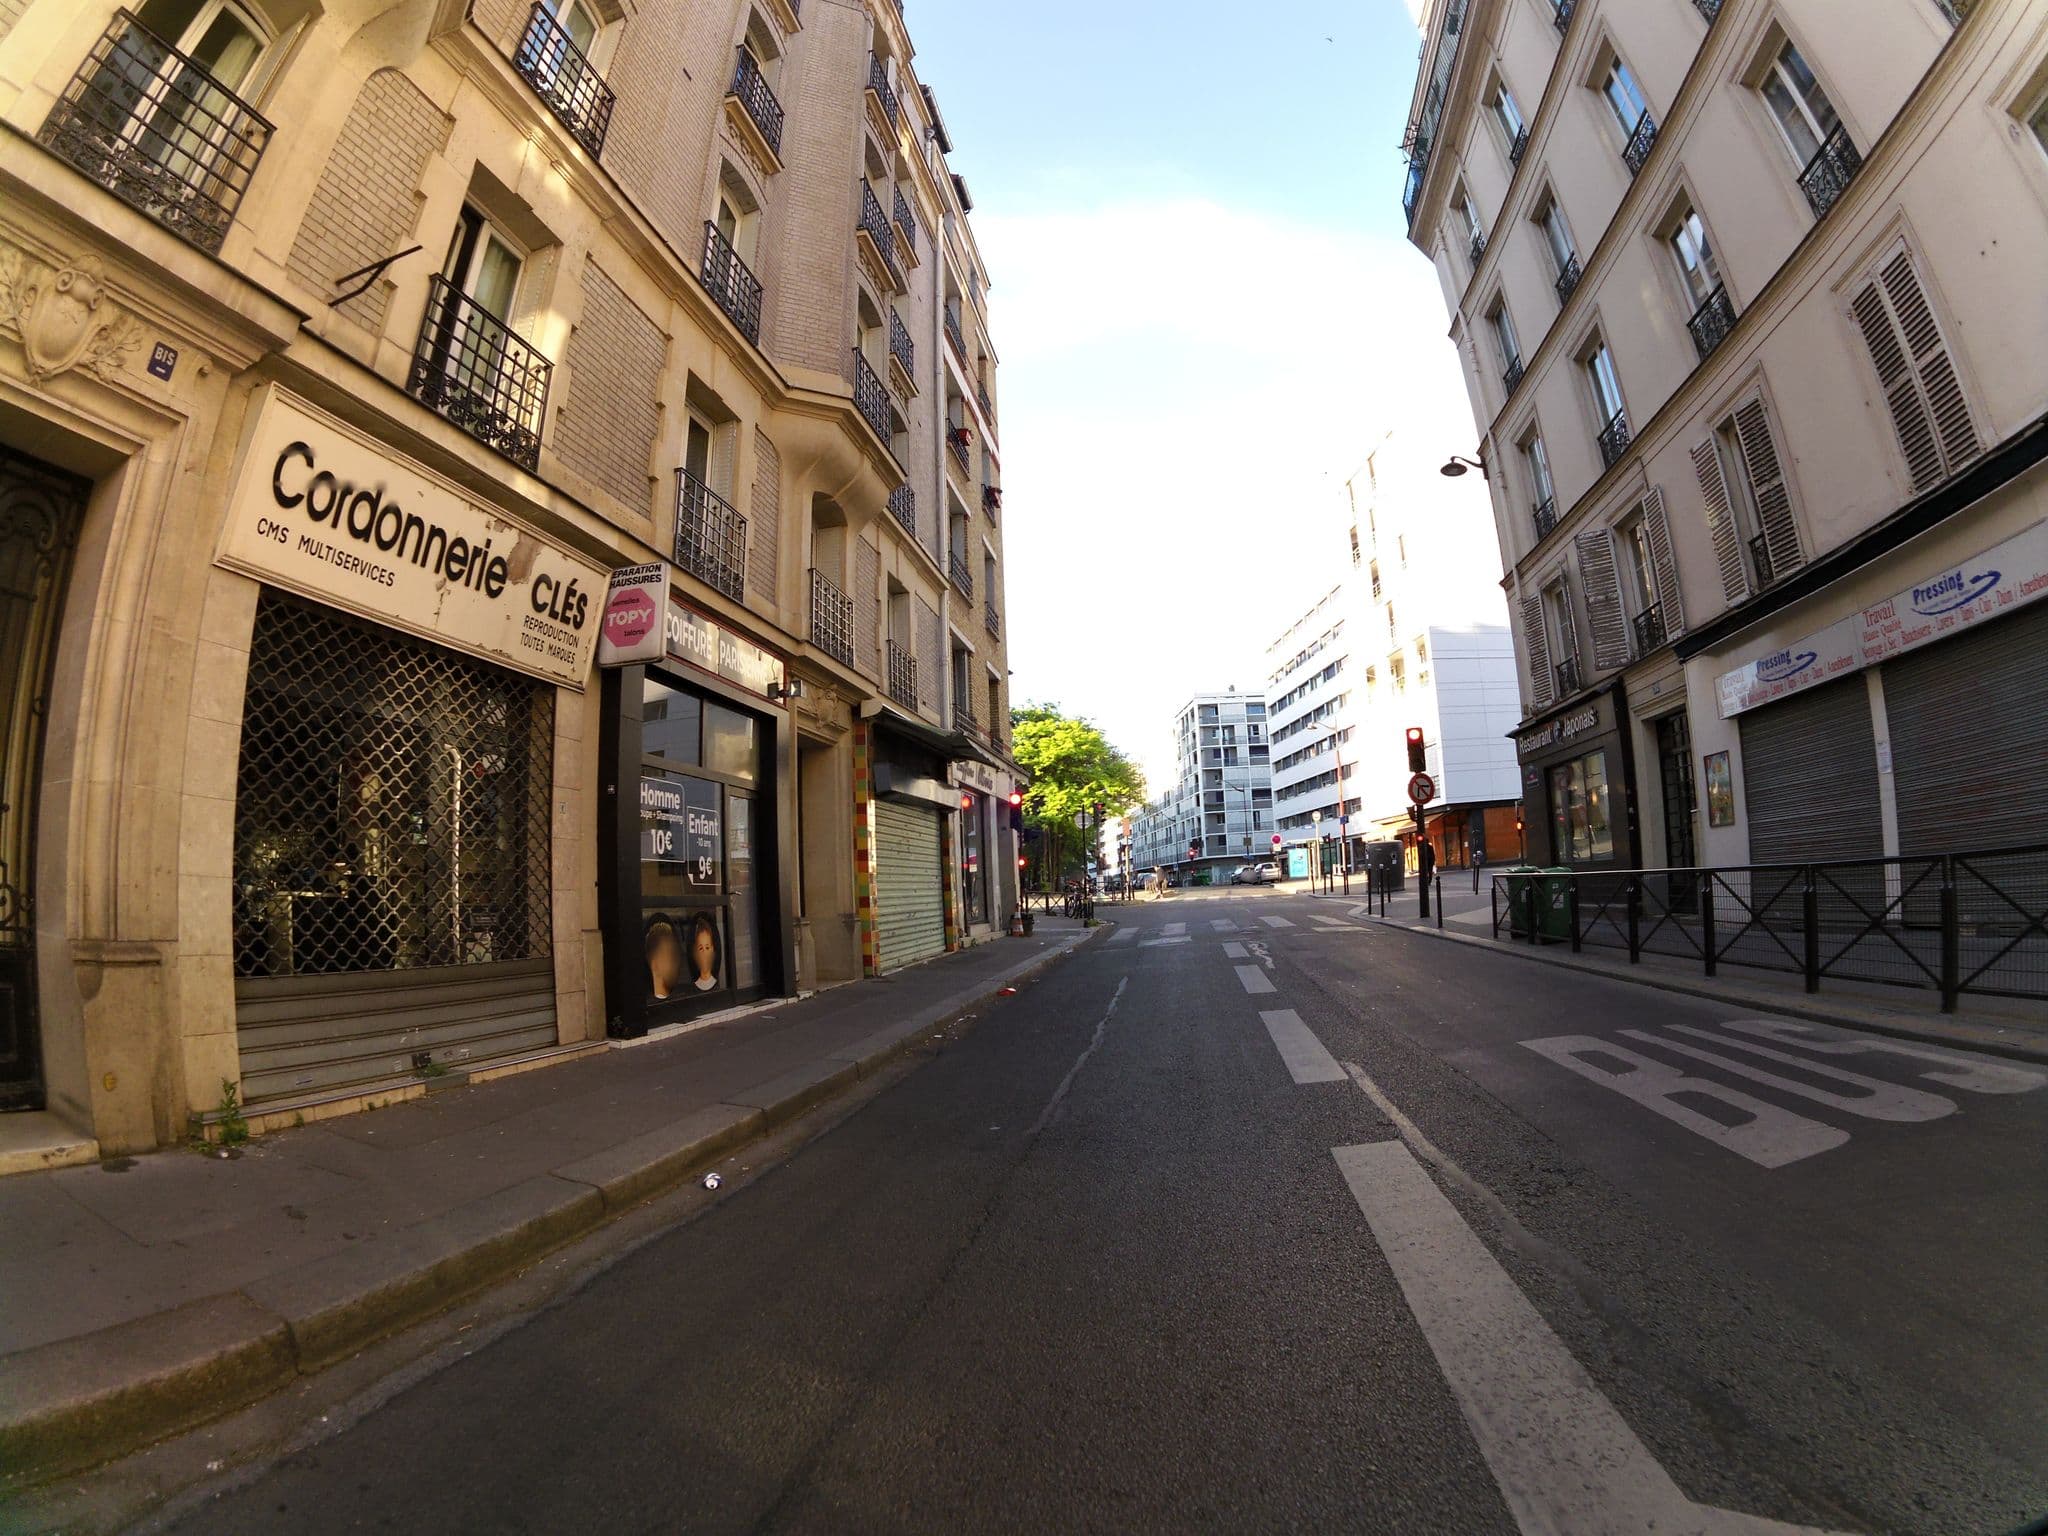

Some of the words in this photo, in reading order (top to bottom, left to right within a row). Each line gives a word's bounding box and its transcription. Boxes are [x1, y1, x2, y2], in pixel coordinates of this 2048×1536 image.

[154, 346, 175, 366] BIS
[273, 441, 508, 598] Cordonnerie
[257, 518, 290, 544] CMS
[298, 535, 395, 587] MULTISERVICES
[531, 573, 588, 630] CLÉS
[1863, 599, 1897, 628] Travail
[1912, 570, 1965, 606] Pressing
[523, 615, 580, 649] REPRODUCTION
[607, 608, 652, 627] TOPY
[520, 632, 545, 652] TOUTES
[546, 643, 576, 665] MARQUES
[666, 611, 712, 661] COIFFURE
[1756, 650, 1792, 675] Pressing
[1519, 726, 1552, 753] Restaurant
[1563, 709, 1596, 739] Japonais
[640, 782, 681, 809] Homme
[688, 813, 719, 836] Enfant
[651, 828, 673, 855] 10€
[699, 855, 713, 880] 9€
[1516, 1020, 2048, 1169] BUS
